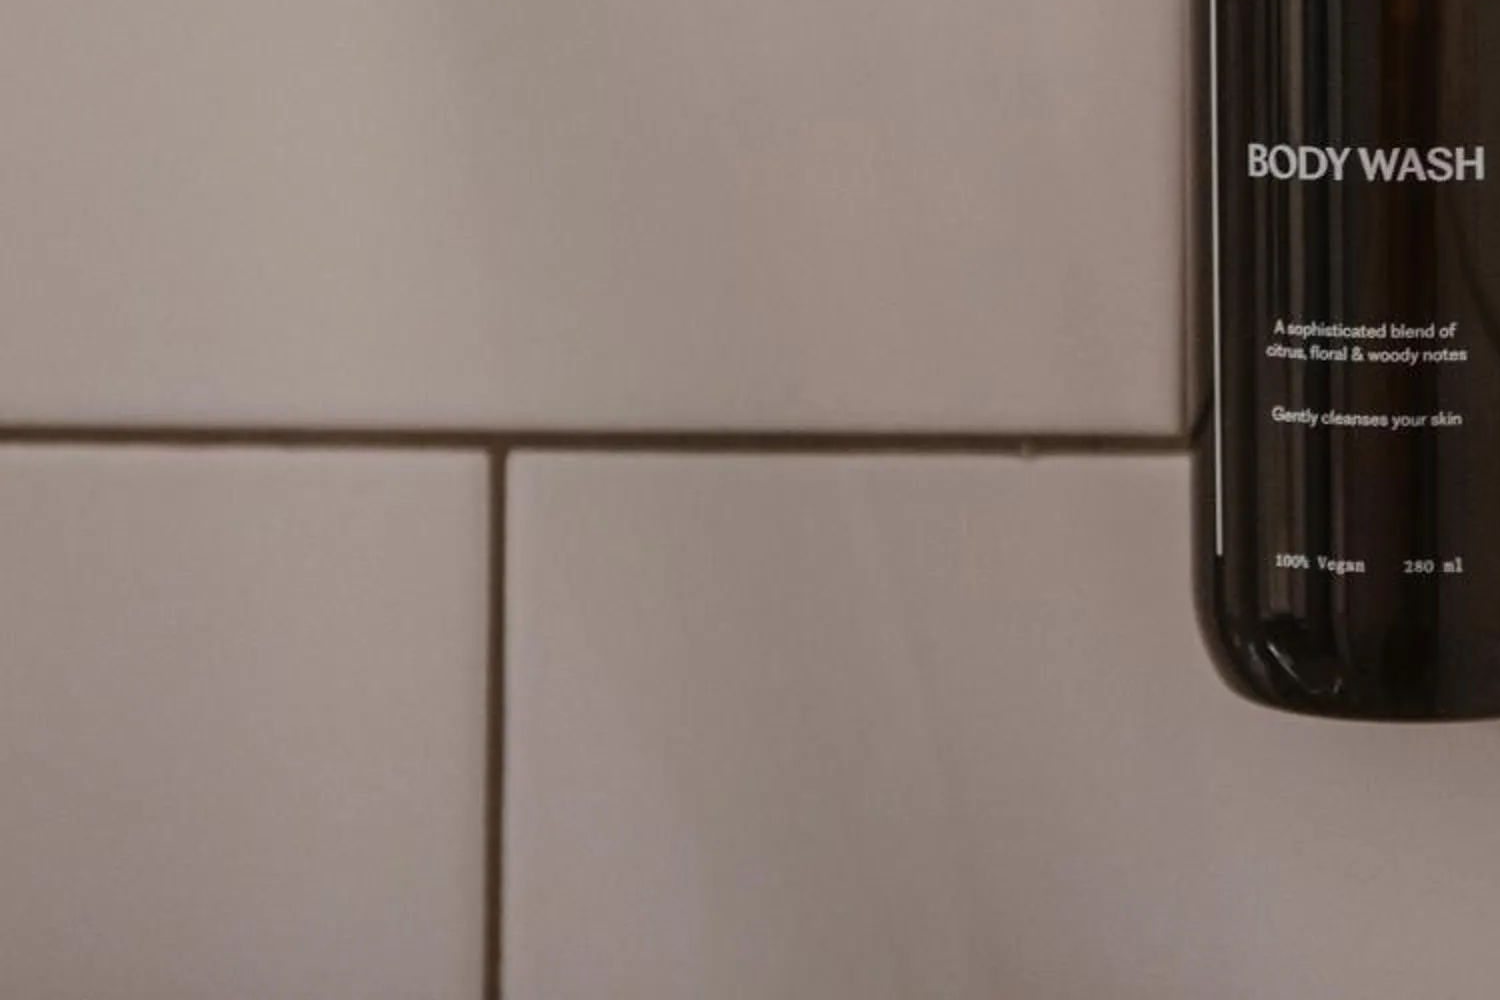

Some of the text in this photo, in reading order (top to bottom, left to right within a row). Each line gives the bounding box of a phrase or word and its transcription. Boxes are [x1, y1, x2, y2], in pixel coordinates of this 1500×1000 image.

[1248, 143, 1485, 181] BODY WASH
[1274, 320, 1456, 340] A sophisticated blend of
[1265, 343, 1468, 366] citrus, floral & woody notes
[1271, 405, 1463, 430] Gently cleanses your skin
[1275, 554, 1365, 575] 100% Vegan
[1404, 557, 1463, 574] 280 ml
